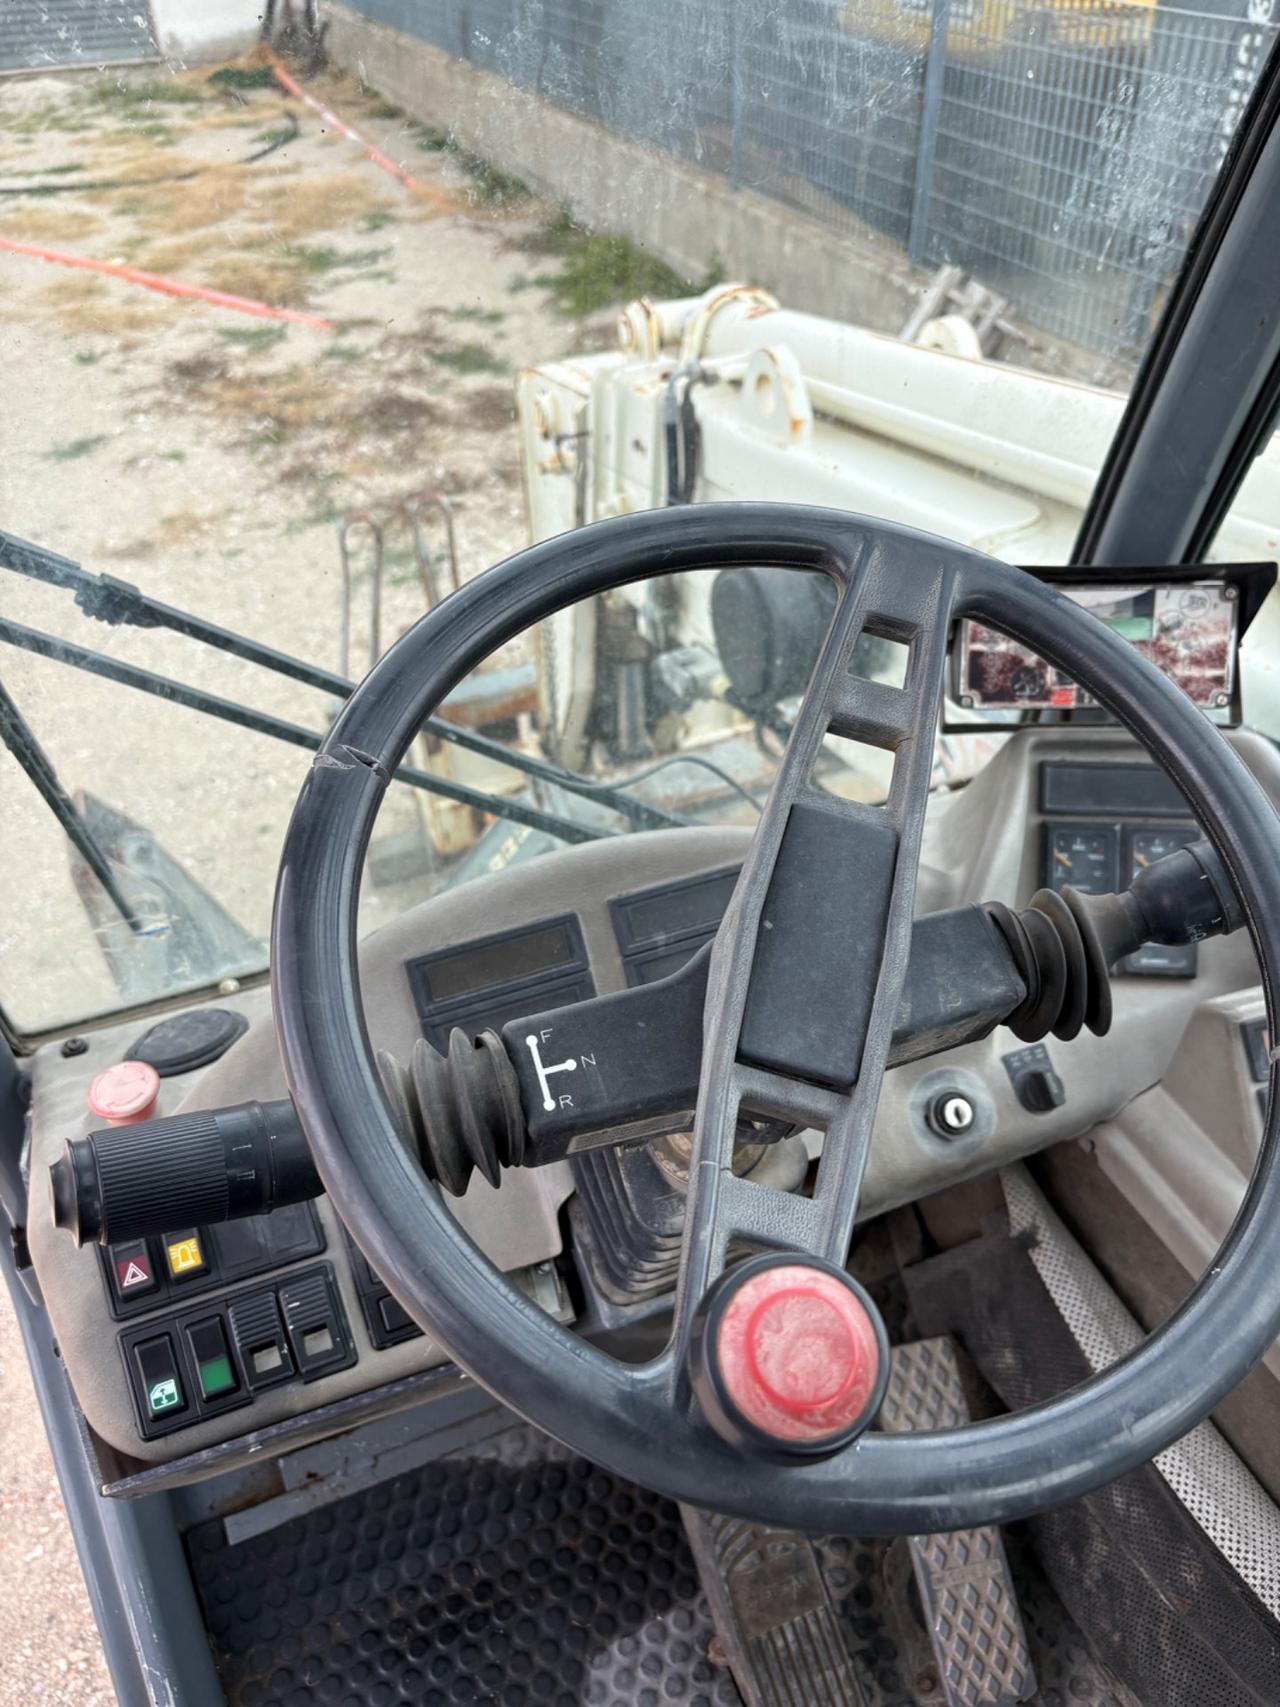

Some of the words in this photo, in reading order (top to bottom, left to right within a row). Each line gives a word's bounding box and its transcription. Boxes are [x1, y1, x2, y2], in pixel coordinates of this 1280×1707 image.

[540, 1028, 553, 1043] F
[580, 1052, 597, 1069] N
[558, 1094, 574, 1109] R
